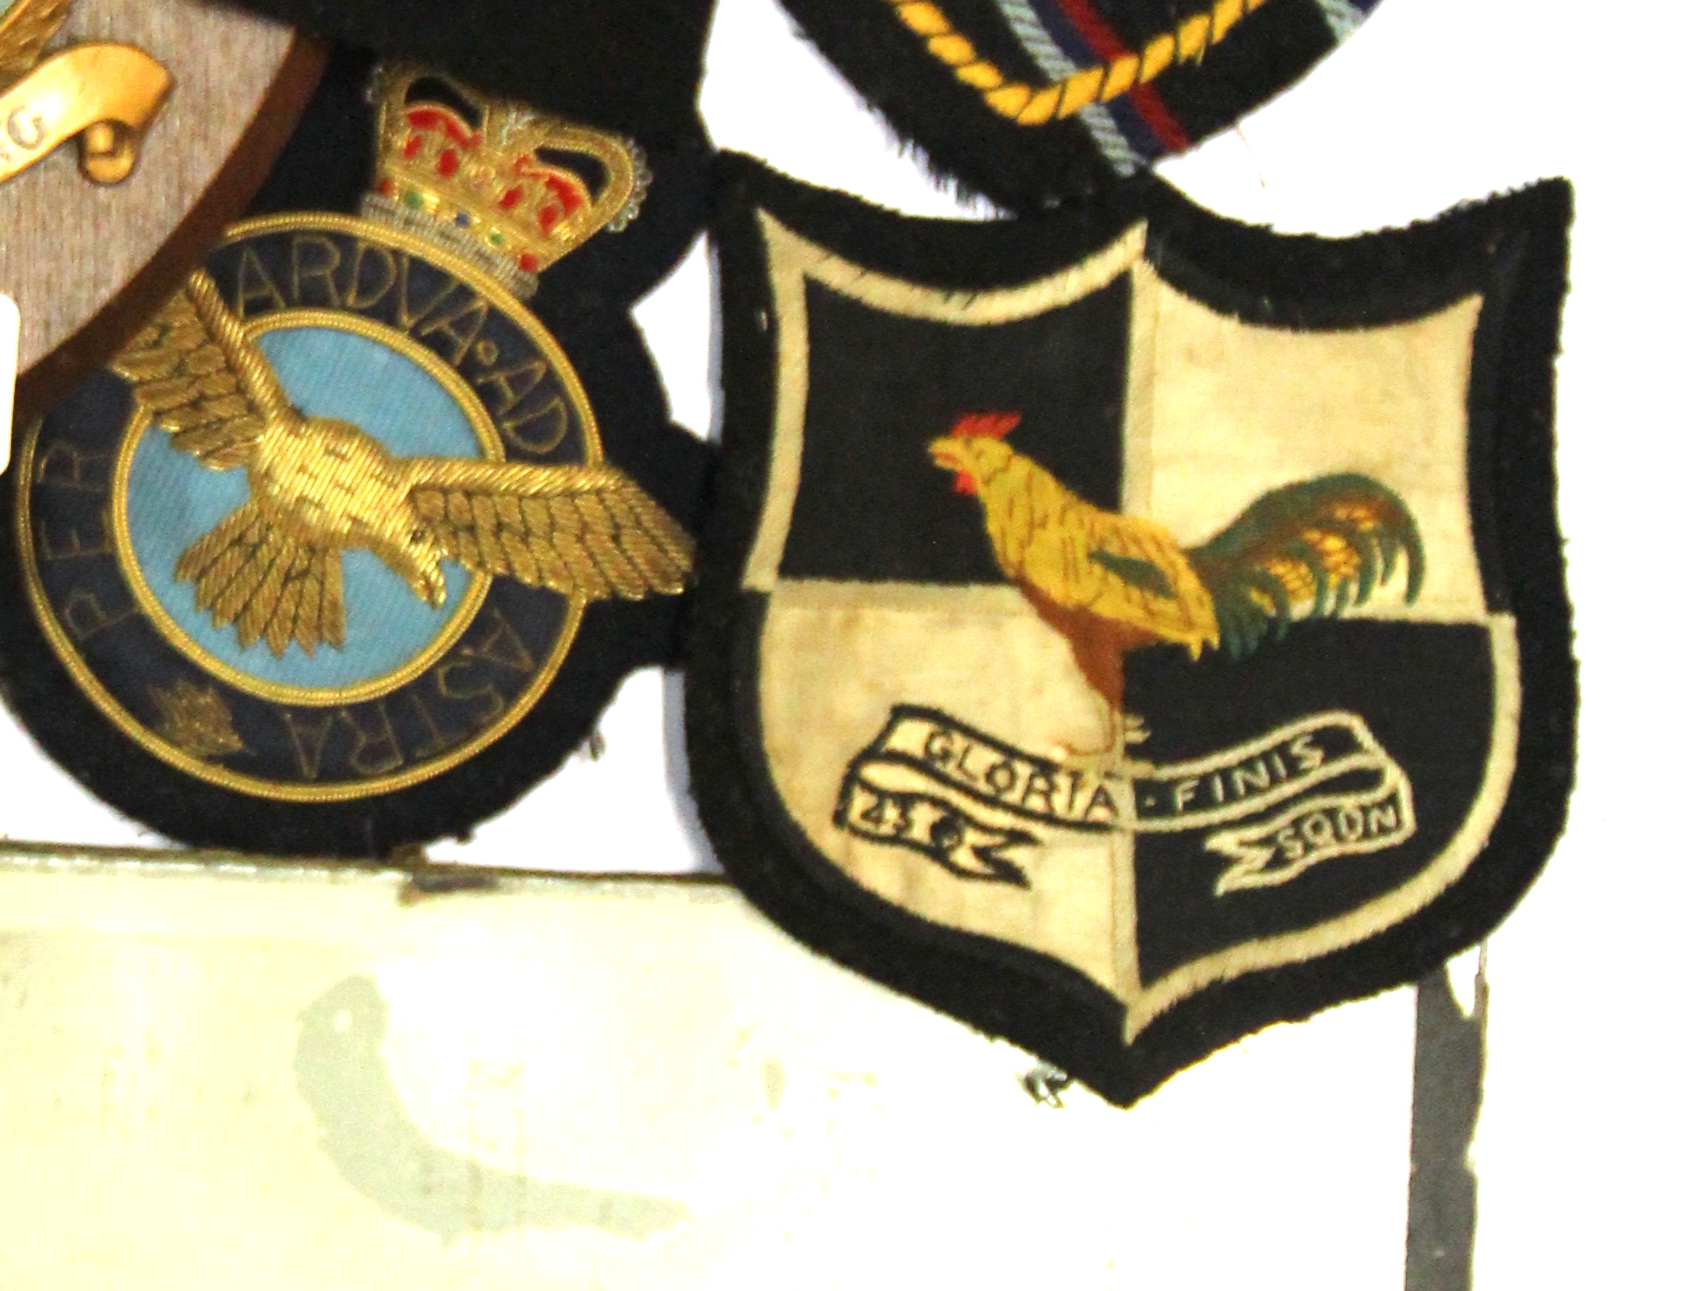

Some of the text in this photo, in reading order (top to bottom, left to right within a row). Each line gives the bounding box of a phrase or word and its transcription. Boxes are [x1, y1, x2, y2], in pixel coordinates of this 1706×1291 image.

[41, 440, 132, 638] PER
[281, 607, 535, 782] ASTRA
[924, 729, 1325, 822] GLORIA FINIS
[1277, 804, 1397, 859] SQDN
